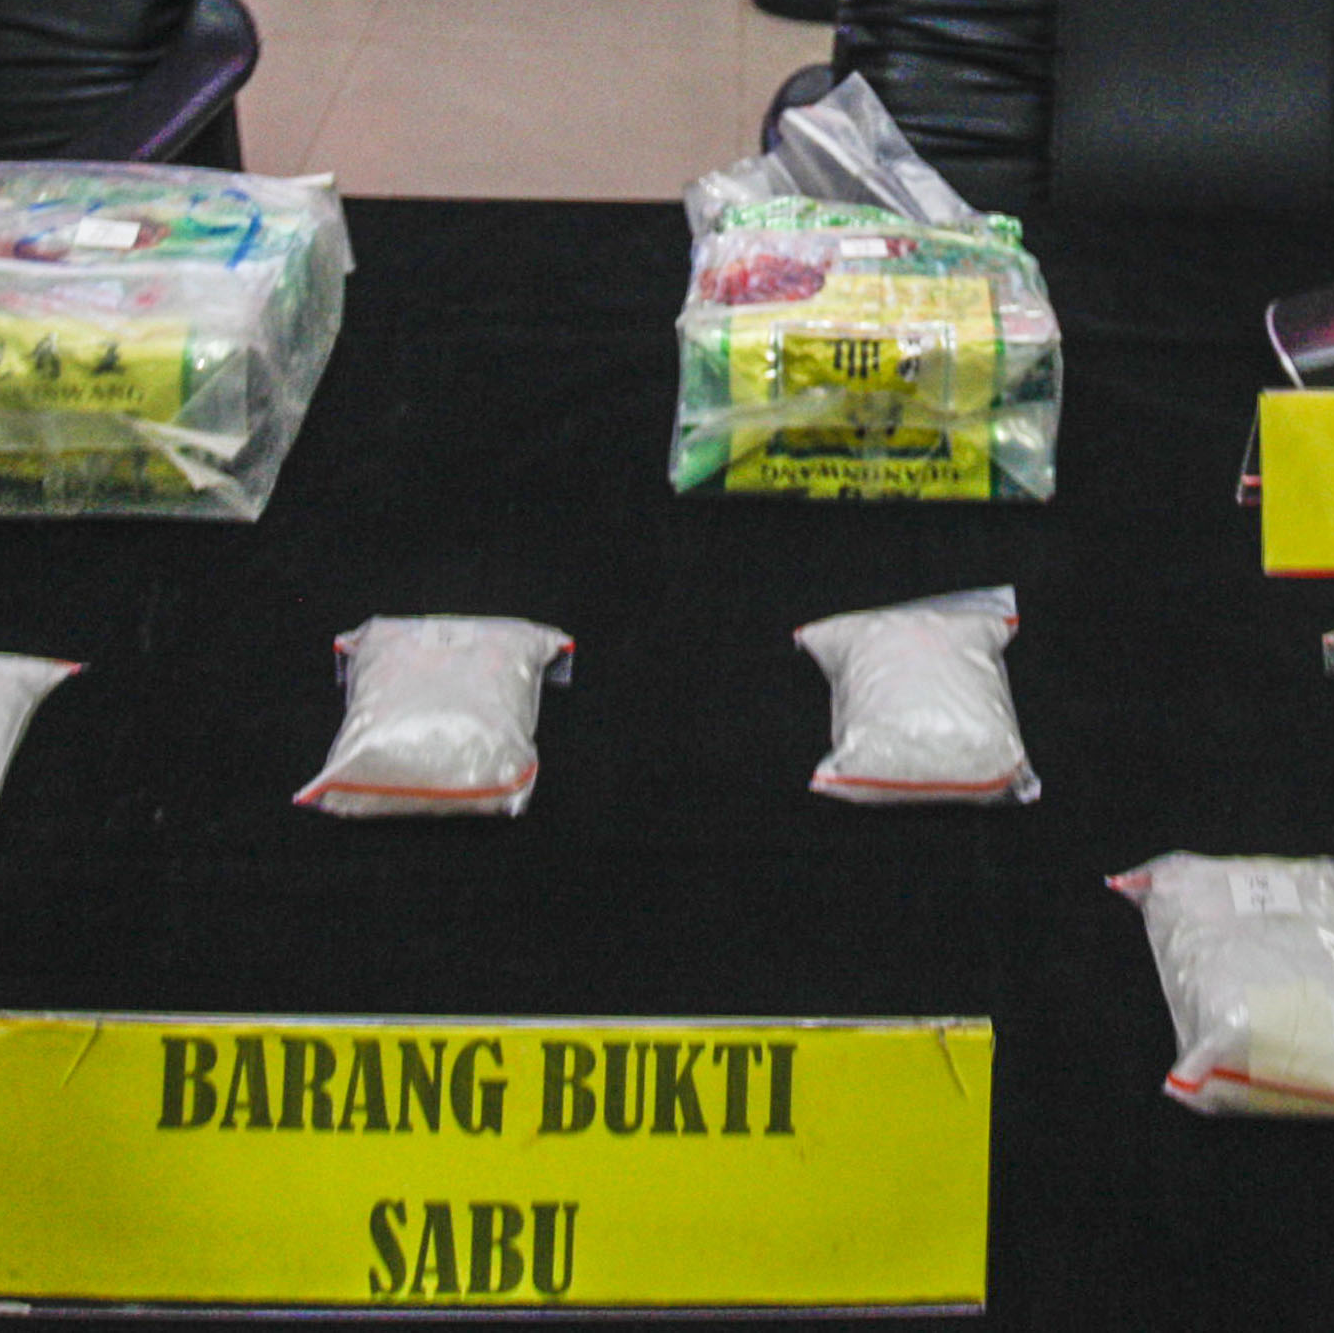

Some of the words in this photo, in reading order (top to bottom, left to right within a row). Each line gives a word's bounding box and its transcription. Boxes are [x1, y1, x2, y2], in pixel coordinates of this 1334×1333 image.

[157, 1034, 506, 1134] BARANG
[537, 1038, 799, 1138] BUKTI
[368, 1198, 580, 1300] SABU
